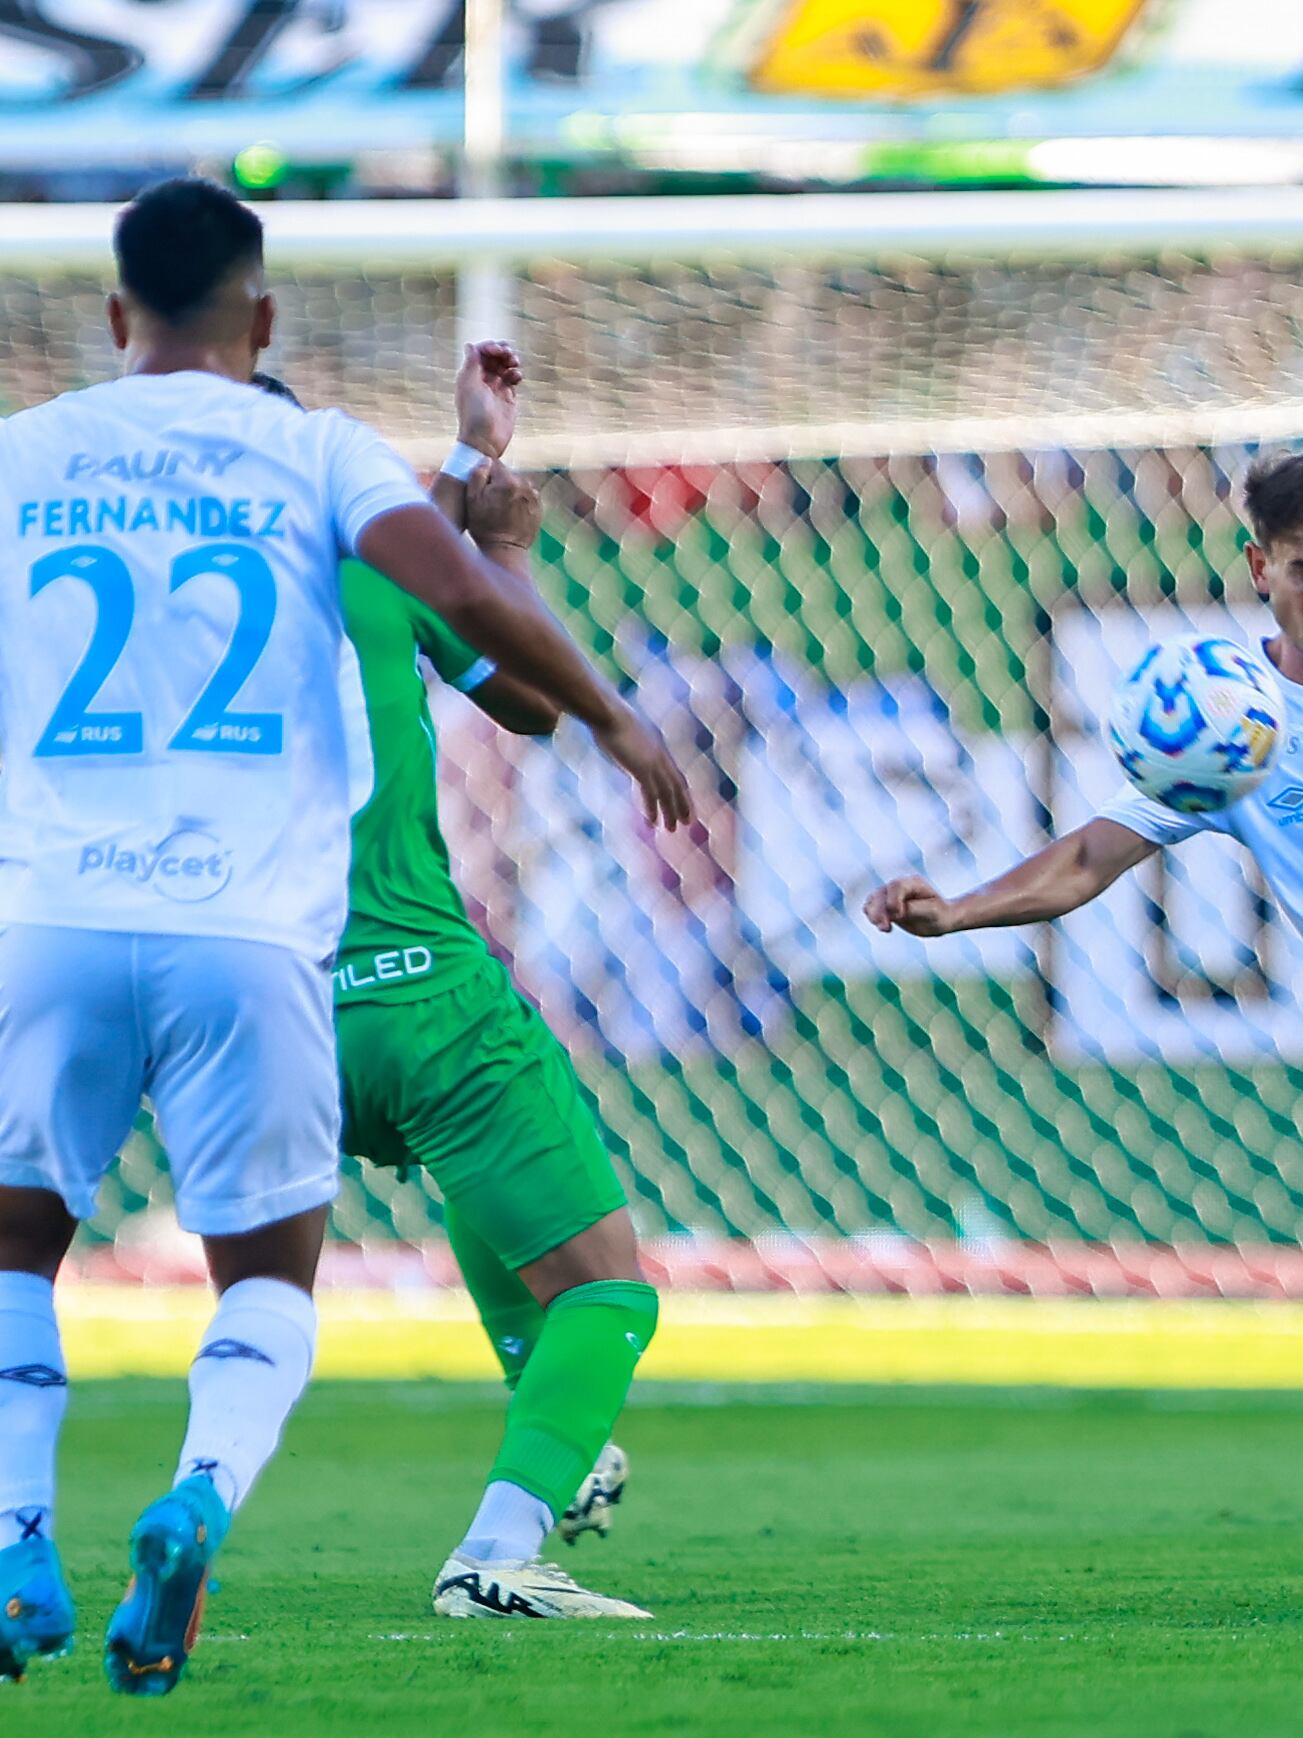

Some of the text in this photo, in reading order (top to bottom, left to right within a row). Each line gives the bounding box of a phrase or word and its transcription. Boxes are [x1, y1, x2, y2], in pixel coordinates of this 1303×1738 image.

[18, 495, 287, 538] FERNANDEZ
[29, 541, 284, 758] 22
[81, 725, 123, 742] RUS
[219, 724, 263, 743] RUS
[77, 843, 222, 883] playcet
